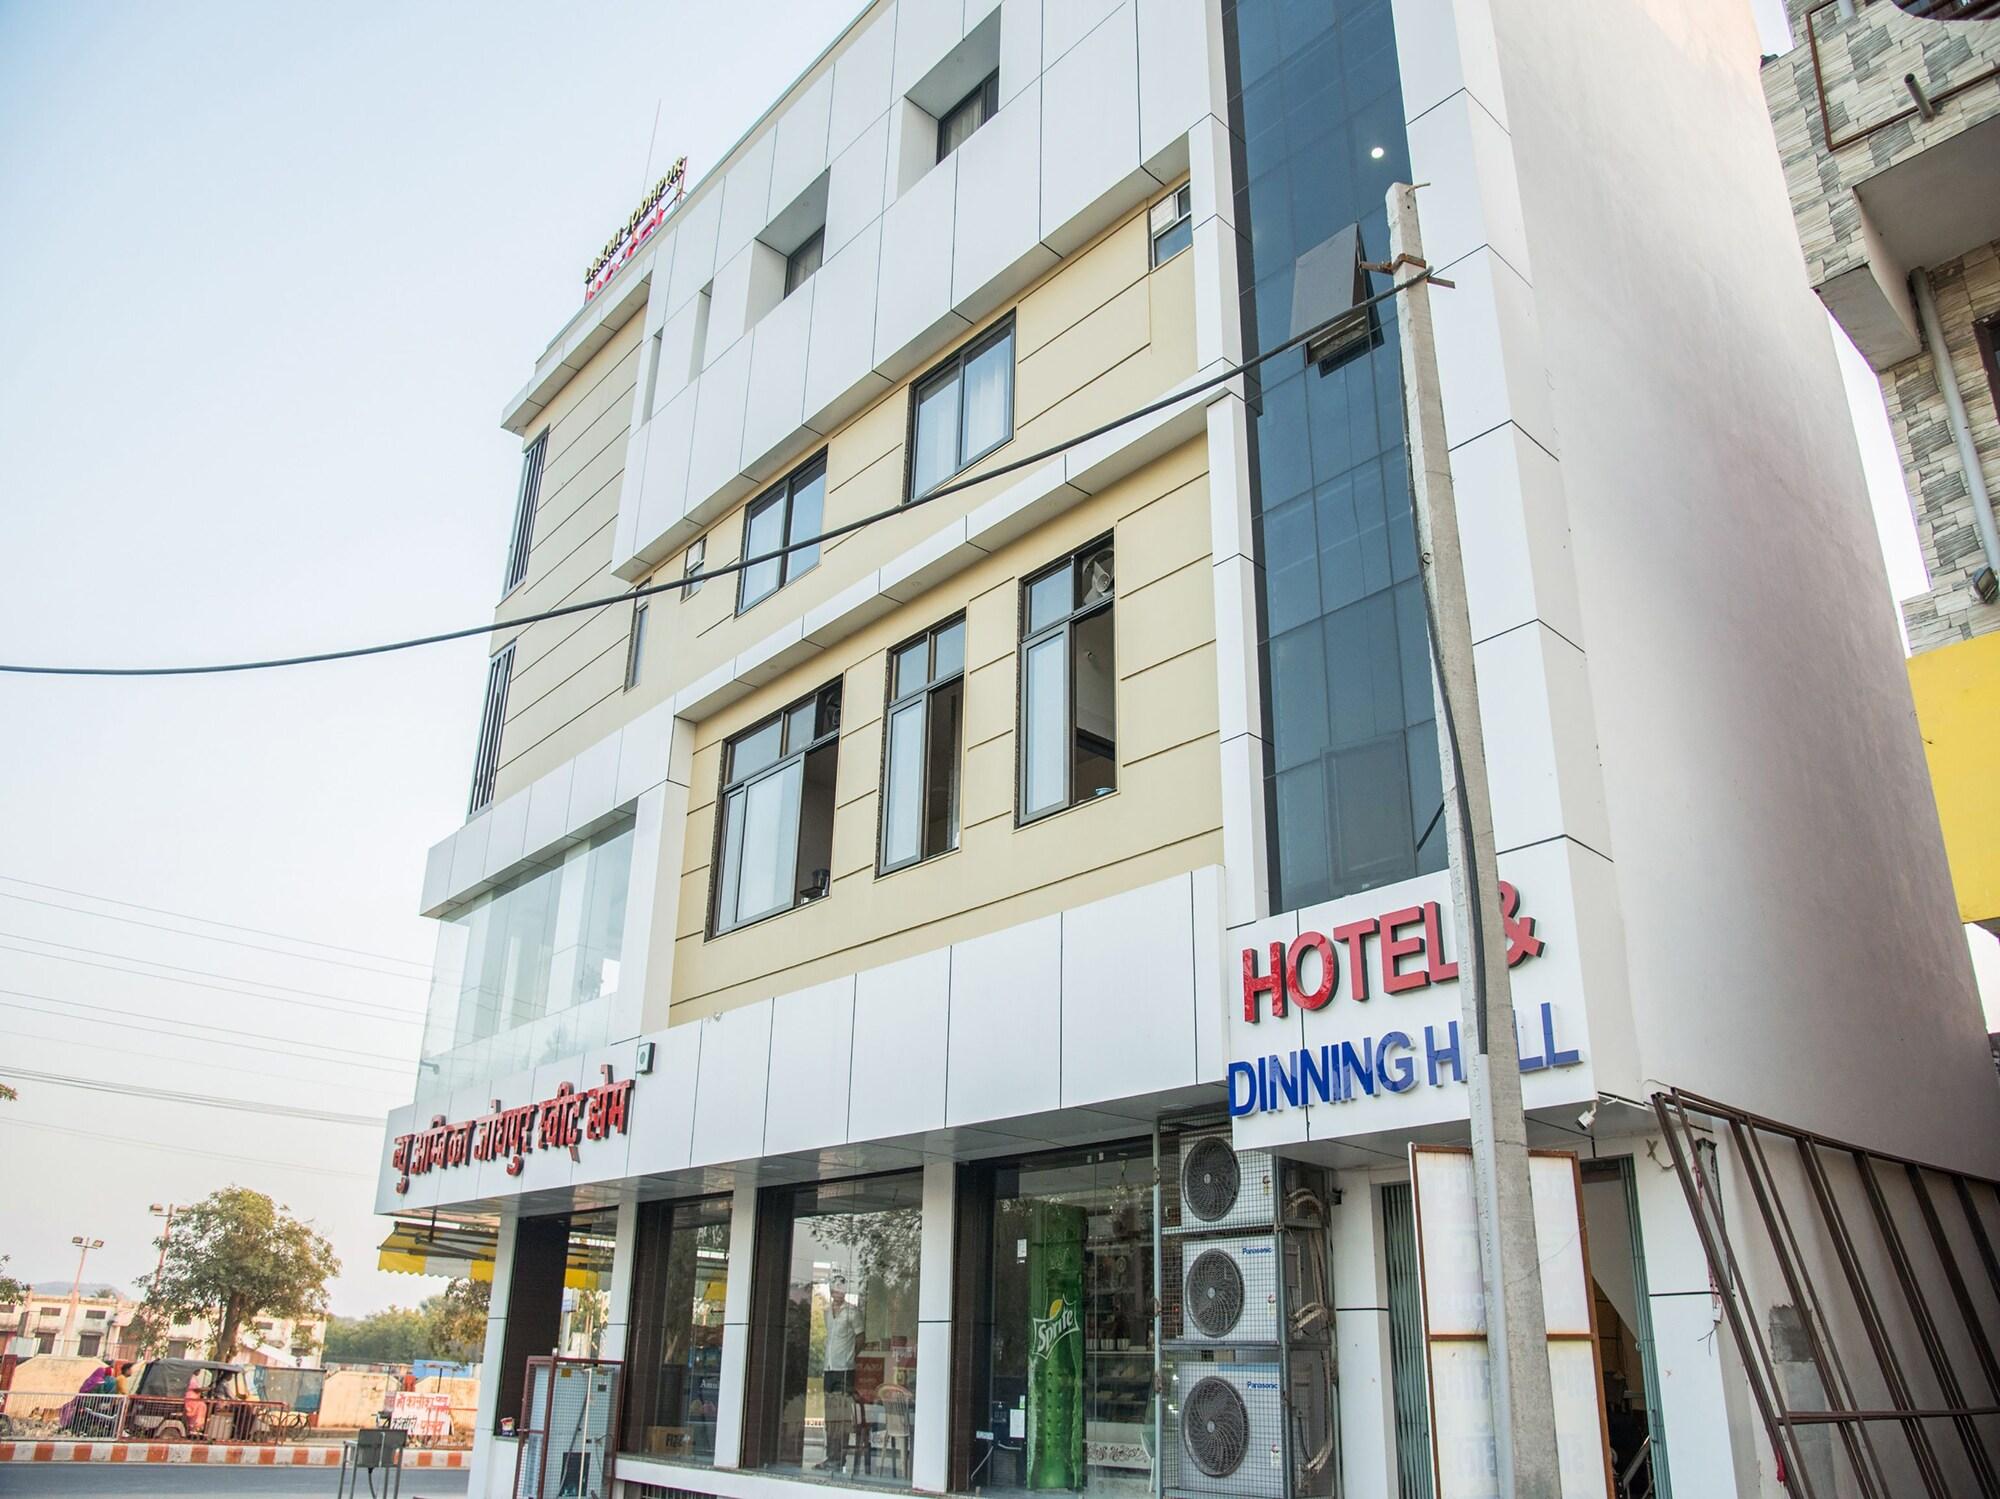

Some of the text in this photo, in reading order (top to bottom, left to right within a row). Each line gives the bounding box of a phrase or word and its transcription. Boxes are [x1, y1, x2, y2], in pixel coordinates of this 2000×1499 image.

[1242, 880, 1546, 1024] HOTEL &
[1228, 1002, 1583, 1118] DINNING HLL
[587, 1064, 635, 1140] होम
[1242, 1247, 1273, 1255] Panasonic
[1037, 1306, 1074, 1353] Sprite
[1247, 1381, 1279, 1390] Panasonic
